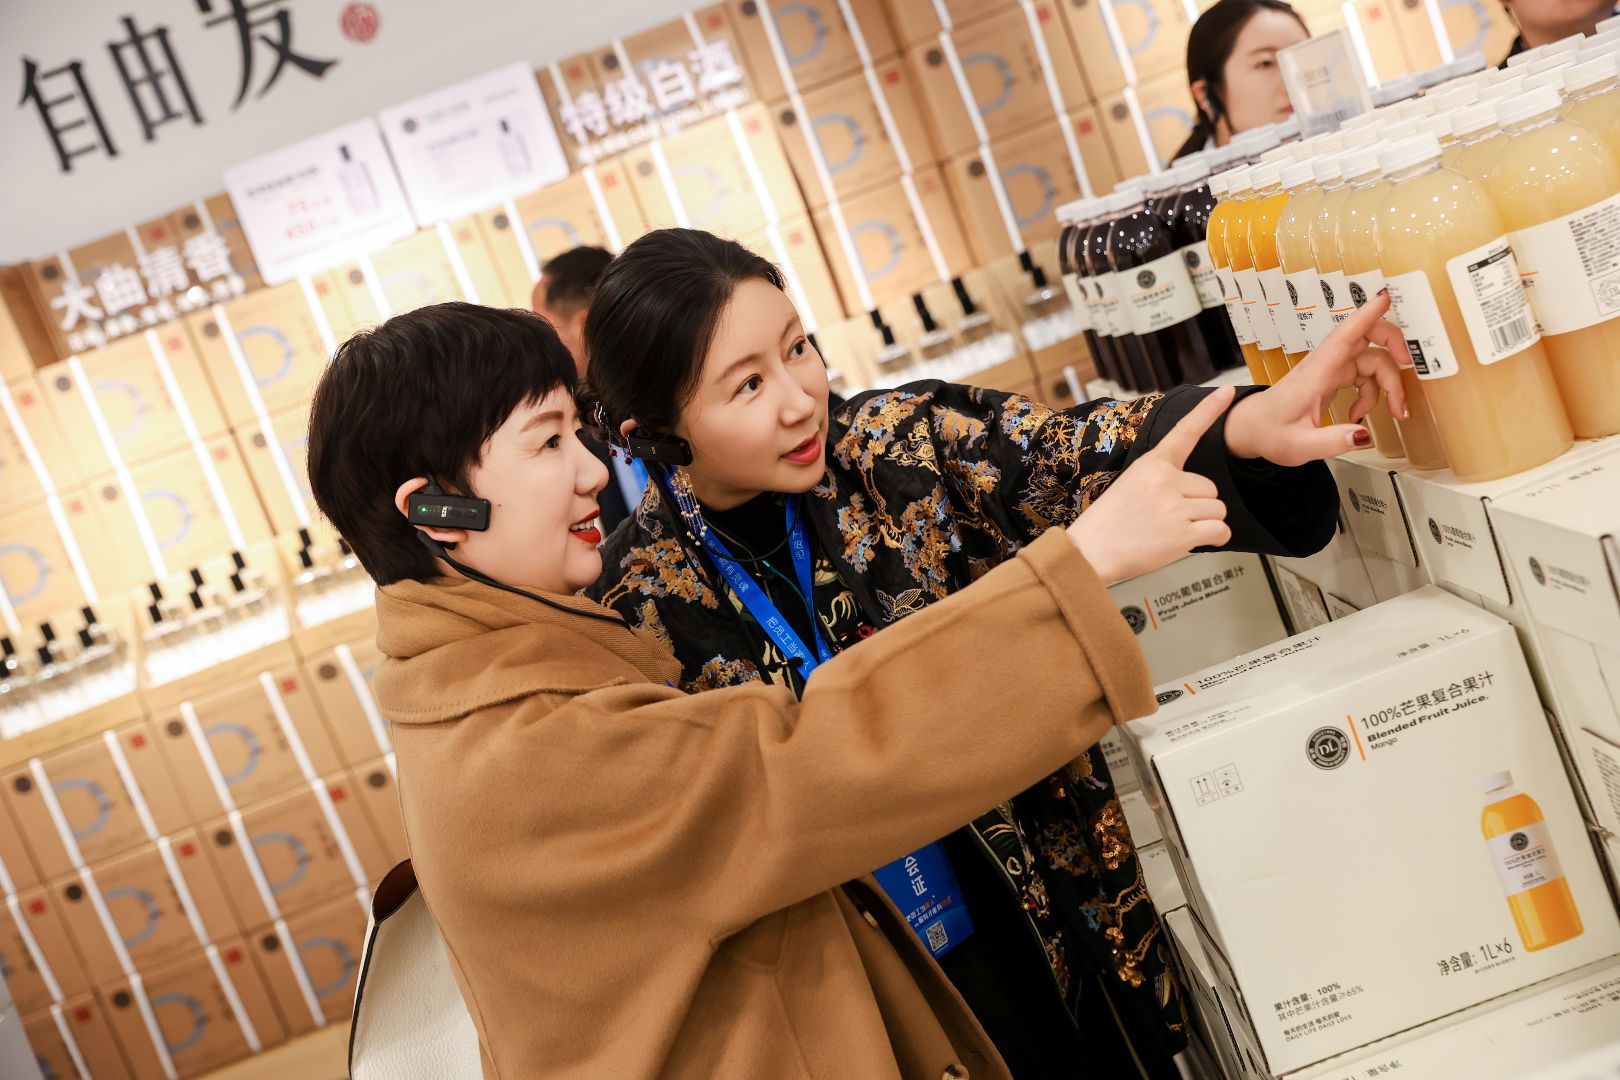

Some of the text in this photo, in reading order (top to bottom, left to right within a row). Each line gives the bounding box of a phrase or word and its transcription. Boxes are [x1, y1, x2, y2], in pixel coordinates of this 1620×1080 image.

[1360, 670, 1494, 729] 100%芒果复合果汁
[1367, 718, 1418, 743] Blended
[1418, 708, 1450, 724] Fruit
[1370, 737, 1398, 751] Mango
[1316, 982, 1341, 996] 100%
[1285, 1032, 1303, 1042] DAILY
[1336, 1013, 1353, 1024] LOVE
